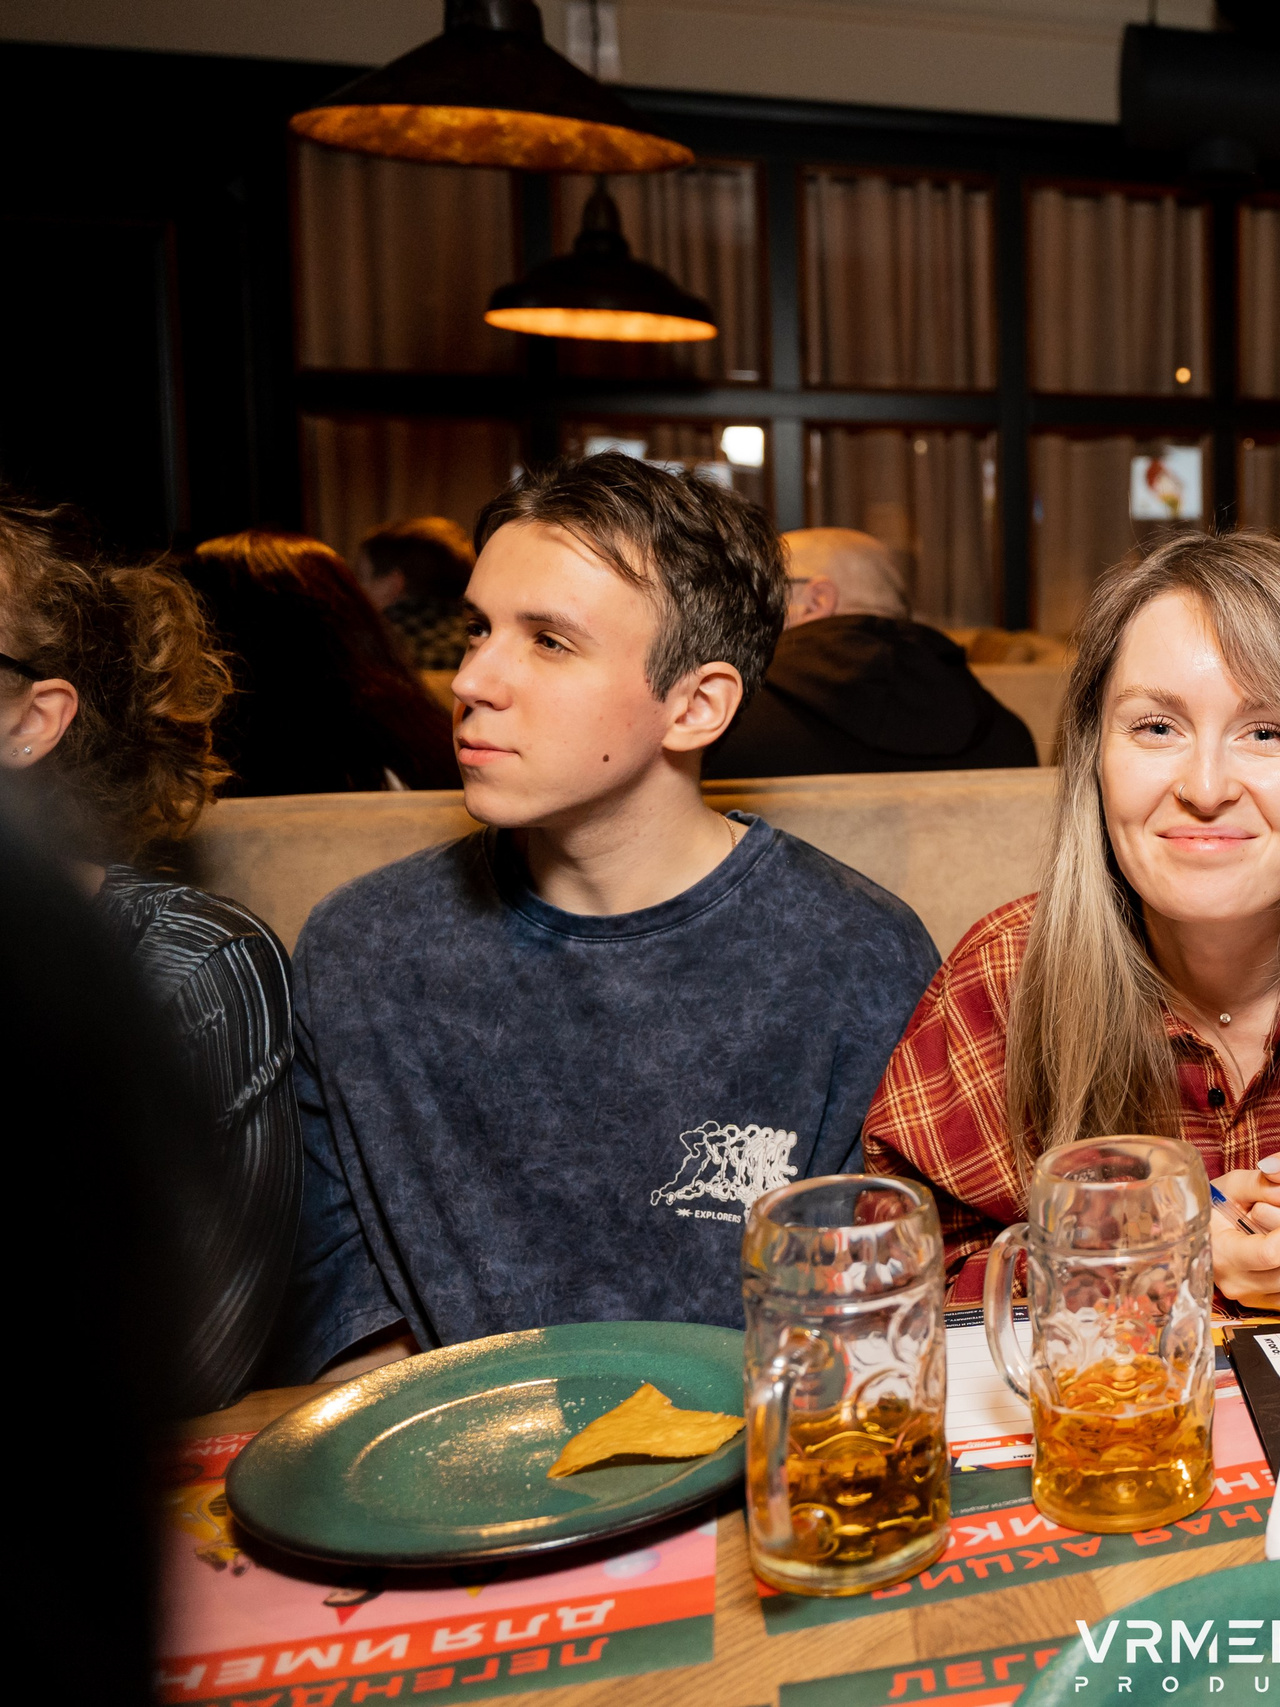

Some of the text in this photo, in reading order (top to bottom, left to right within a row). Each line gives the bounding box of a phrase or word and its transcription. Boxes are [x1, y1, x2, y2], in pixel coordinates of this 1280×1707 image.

[694, 1209, 742, 1224] EXPLORERS
[1131, 1505, 1276, 1547] НАЯ
[158, 1599, 616, 1690] ДЛЯ ИМЕН
